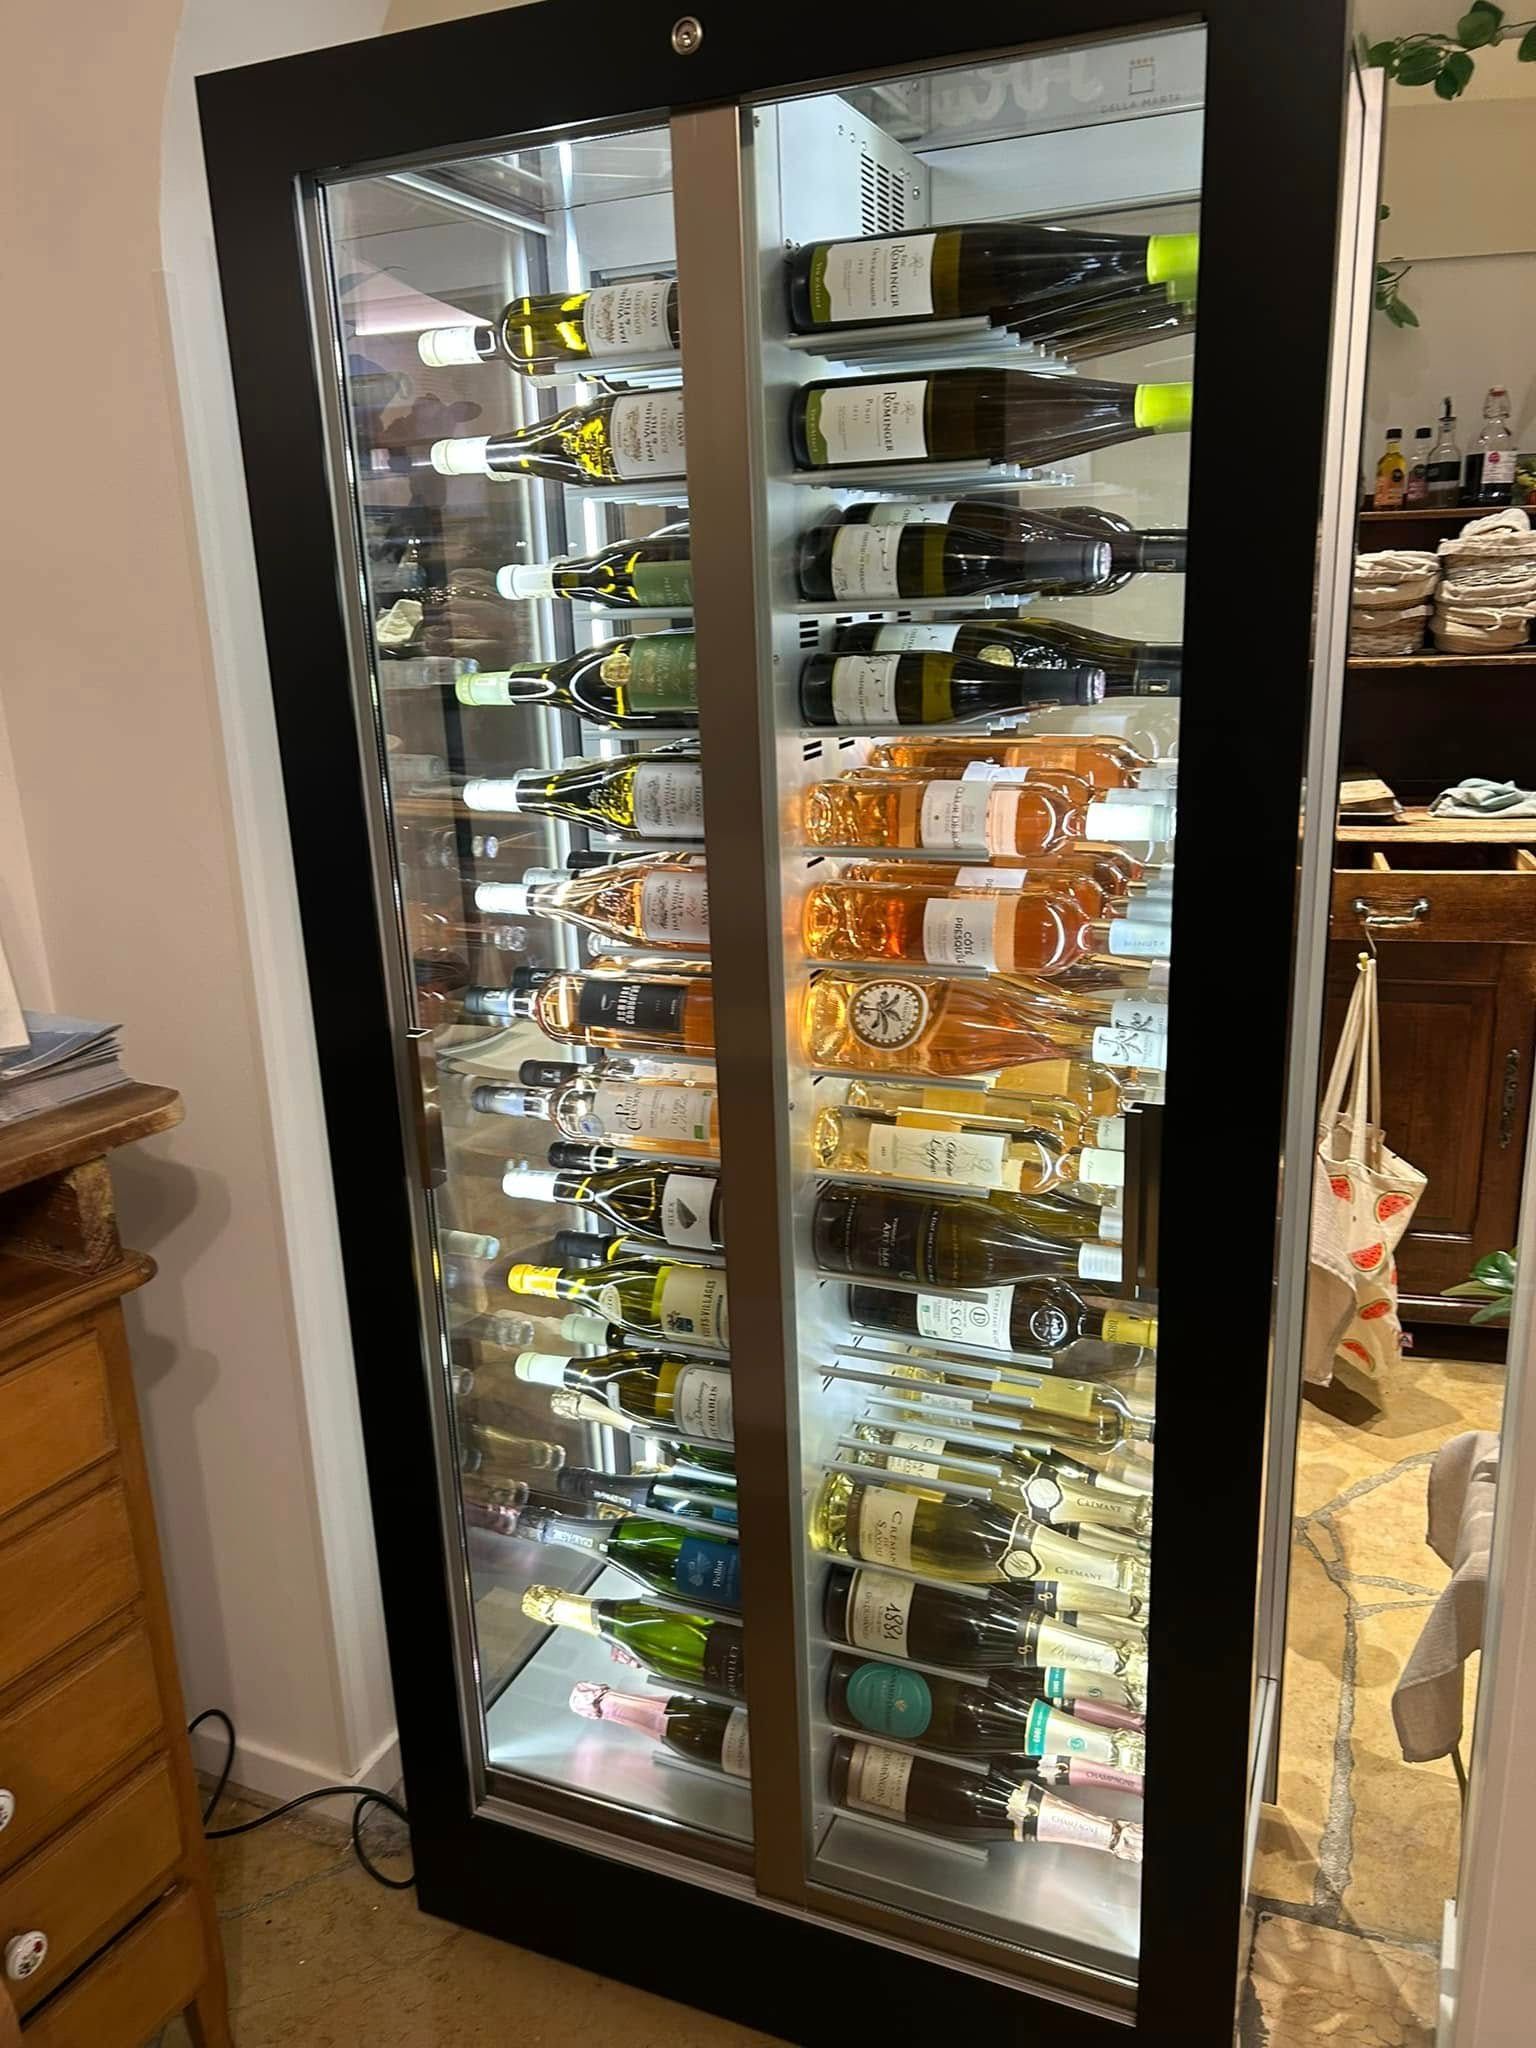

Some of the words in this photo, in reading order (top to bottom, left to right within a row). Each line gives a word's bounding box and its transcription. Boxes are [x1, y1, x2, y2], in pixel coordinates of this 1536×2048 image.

[889, 244, 907, 309] ROMINGER
[624, 297, 632, 315] FILS
[650, 292, 659, 328] SAVOIE
[617, 321, 629, 344] JEAN
[881, 391, 898, 452] ROMINGER
[644, 441, 656, 462] JEAN
[884, 1602, 904, 1640] 1881
